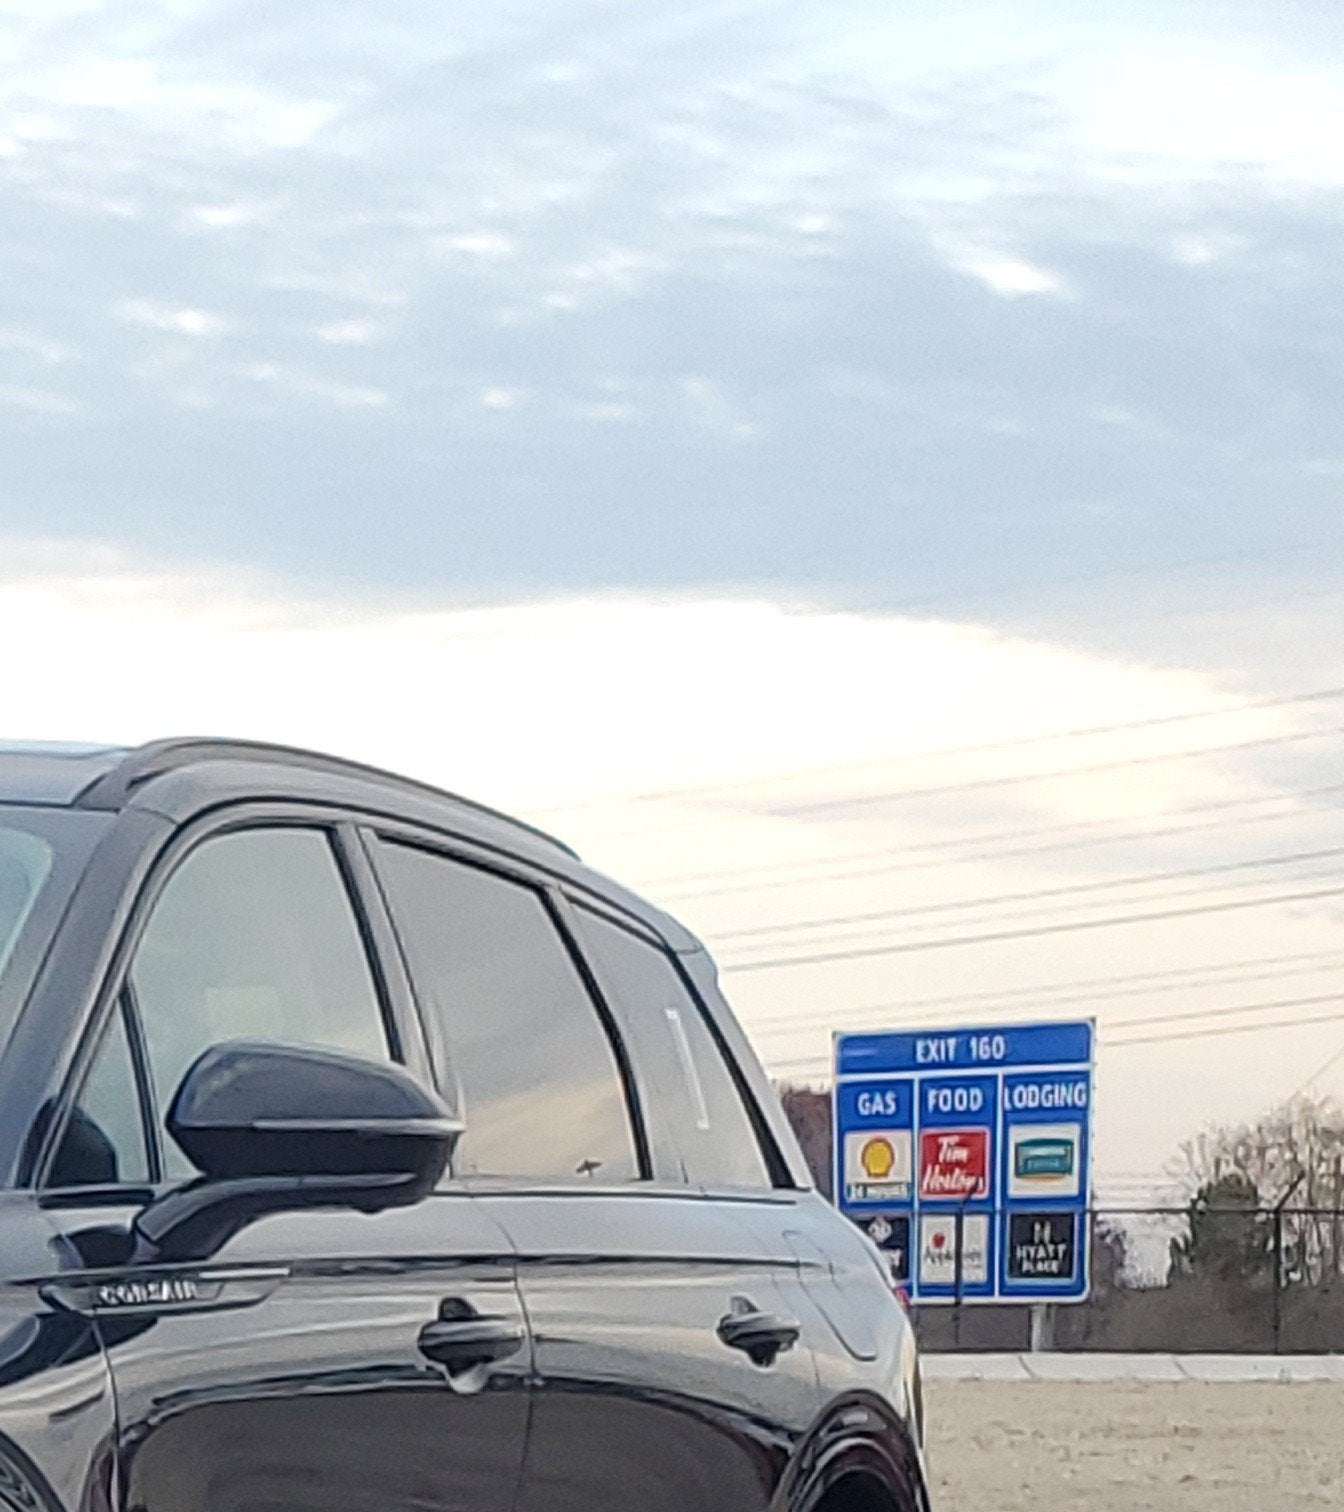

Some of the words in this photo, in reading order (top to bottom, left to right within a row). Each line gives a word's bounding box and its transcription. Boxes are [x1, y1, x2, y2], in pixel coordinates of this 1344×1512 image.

[915, 1037, 958, 1063] EXIT
[970, 1035, 1006, 1060] 160
[857, 1090, 897, 1116] GAS
[927, 1087, 984, 1113] FOOD
[1003, 1082, 1088, 1109] LODGING
[937, 1135, 969, 1163] Tim
[1015, 1243, 1067, 1261] HYATT
[1021, 1259, 1060, 1274] PLACE
